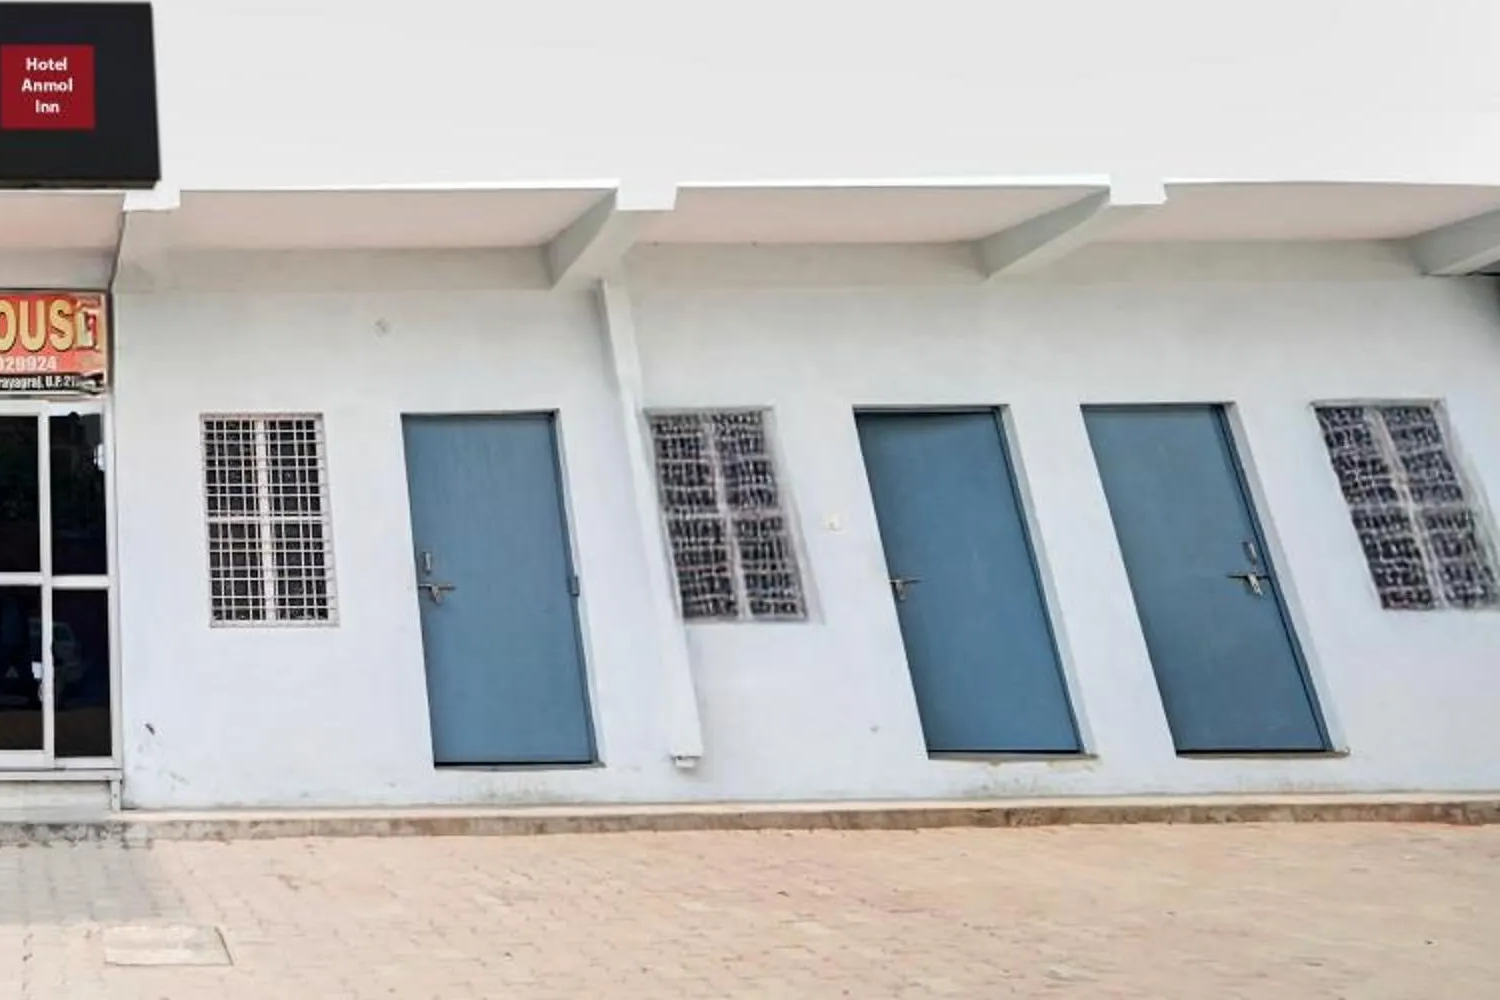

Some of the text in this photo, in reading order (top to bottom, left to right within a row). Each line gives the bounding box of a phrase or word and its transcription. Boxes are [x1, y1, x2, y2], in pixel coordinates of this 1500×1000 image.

[26, 57, 68, 72] Hotel
[21, 77, 74, 93] Anmol
[35, 99, 60, 114] Inn
